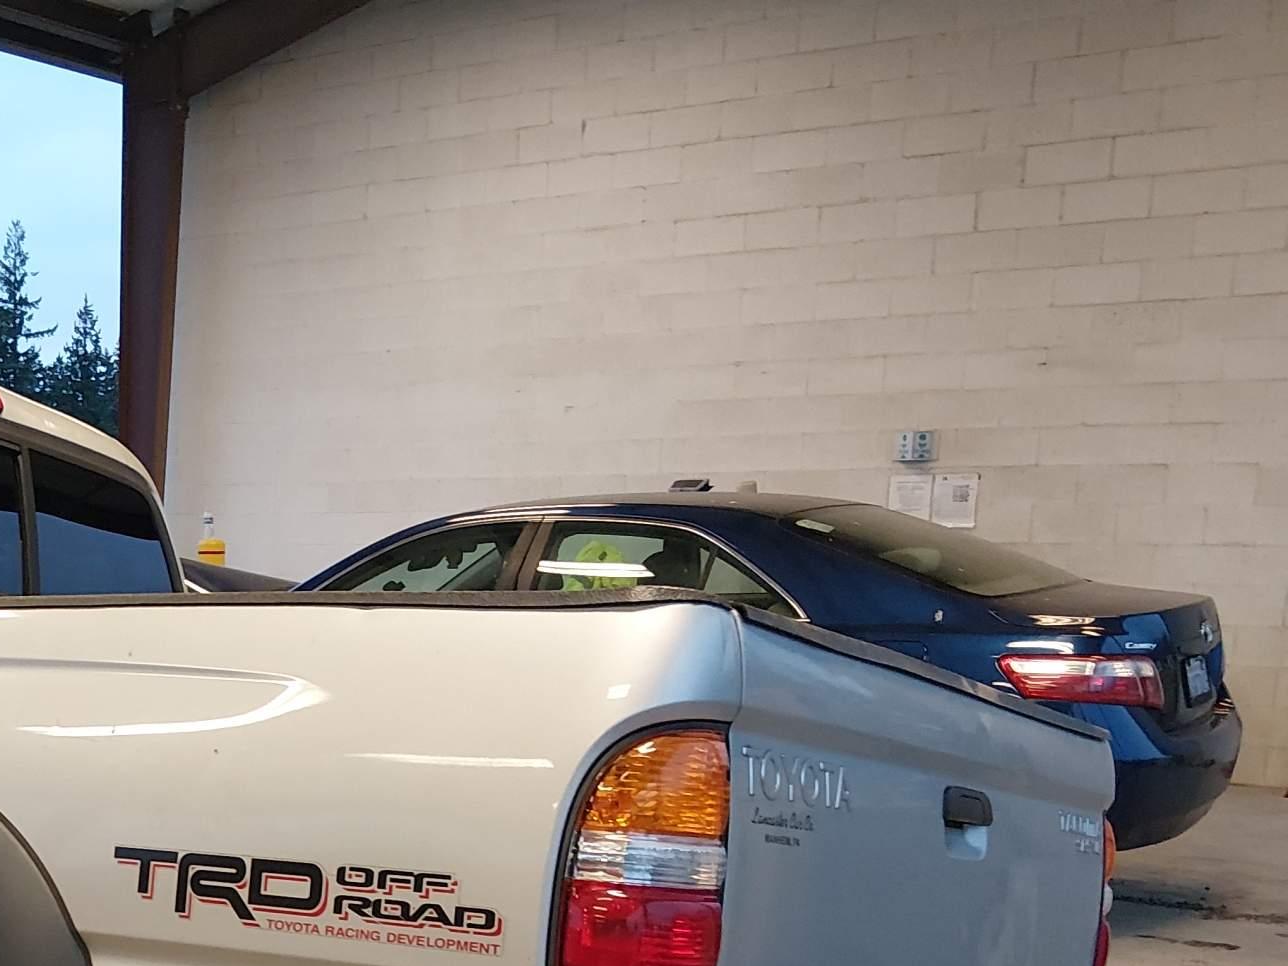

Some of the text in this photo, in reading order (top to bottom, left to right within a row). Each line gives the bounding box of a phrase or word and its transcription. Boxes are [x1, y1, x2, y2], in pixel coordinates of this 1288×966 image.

[741, 744, 851, 812] TOYOTA
[114, 845, 328, 927] TRD
[336, 865, 459, 899] OFF
[266, 917, 502, 956] TOYOTA RACING DEVELOPMENT
[332, 894, 503, 938] ROAD
